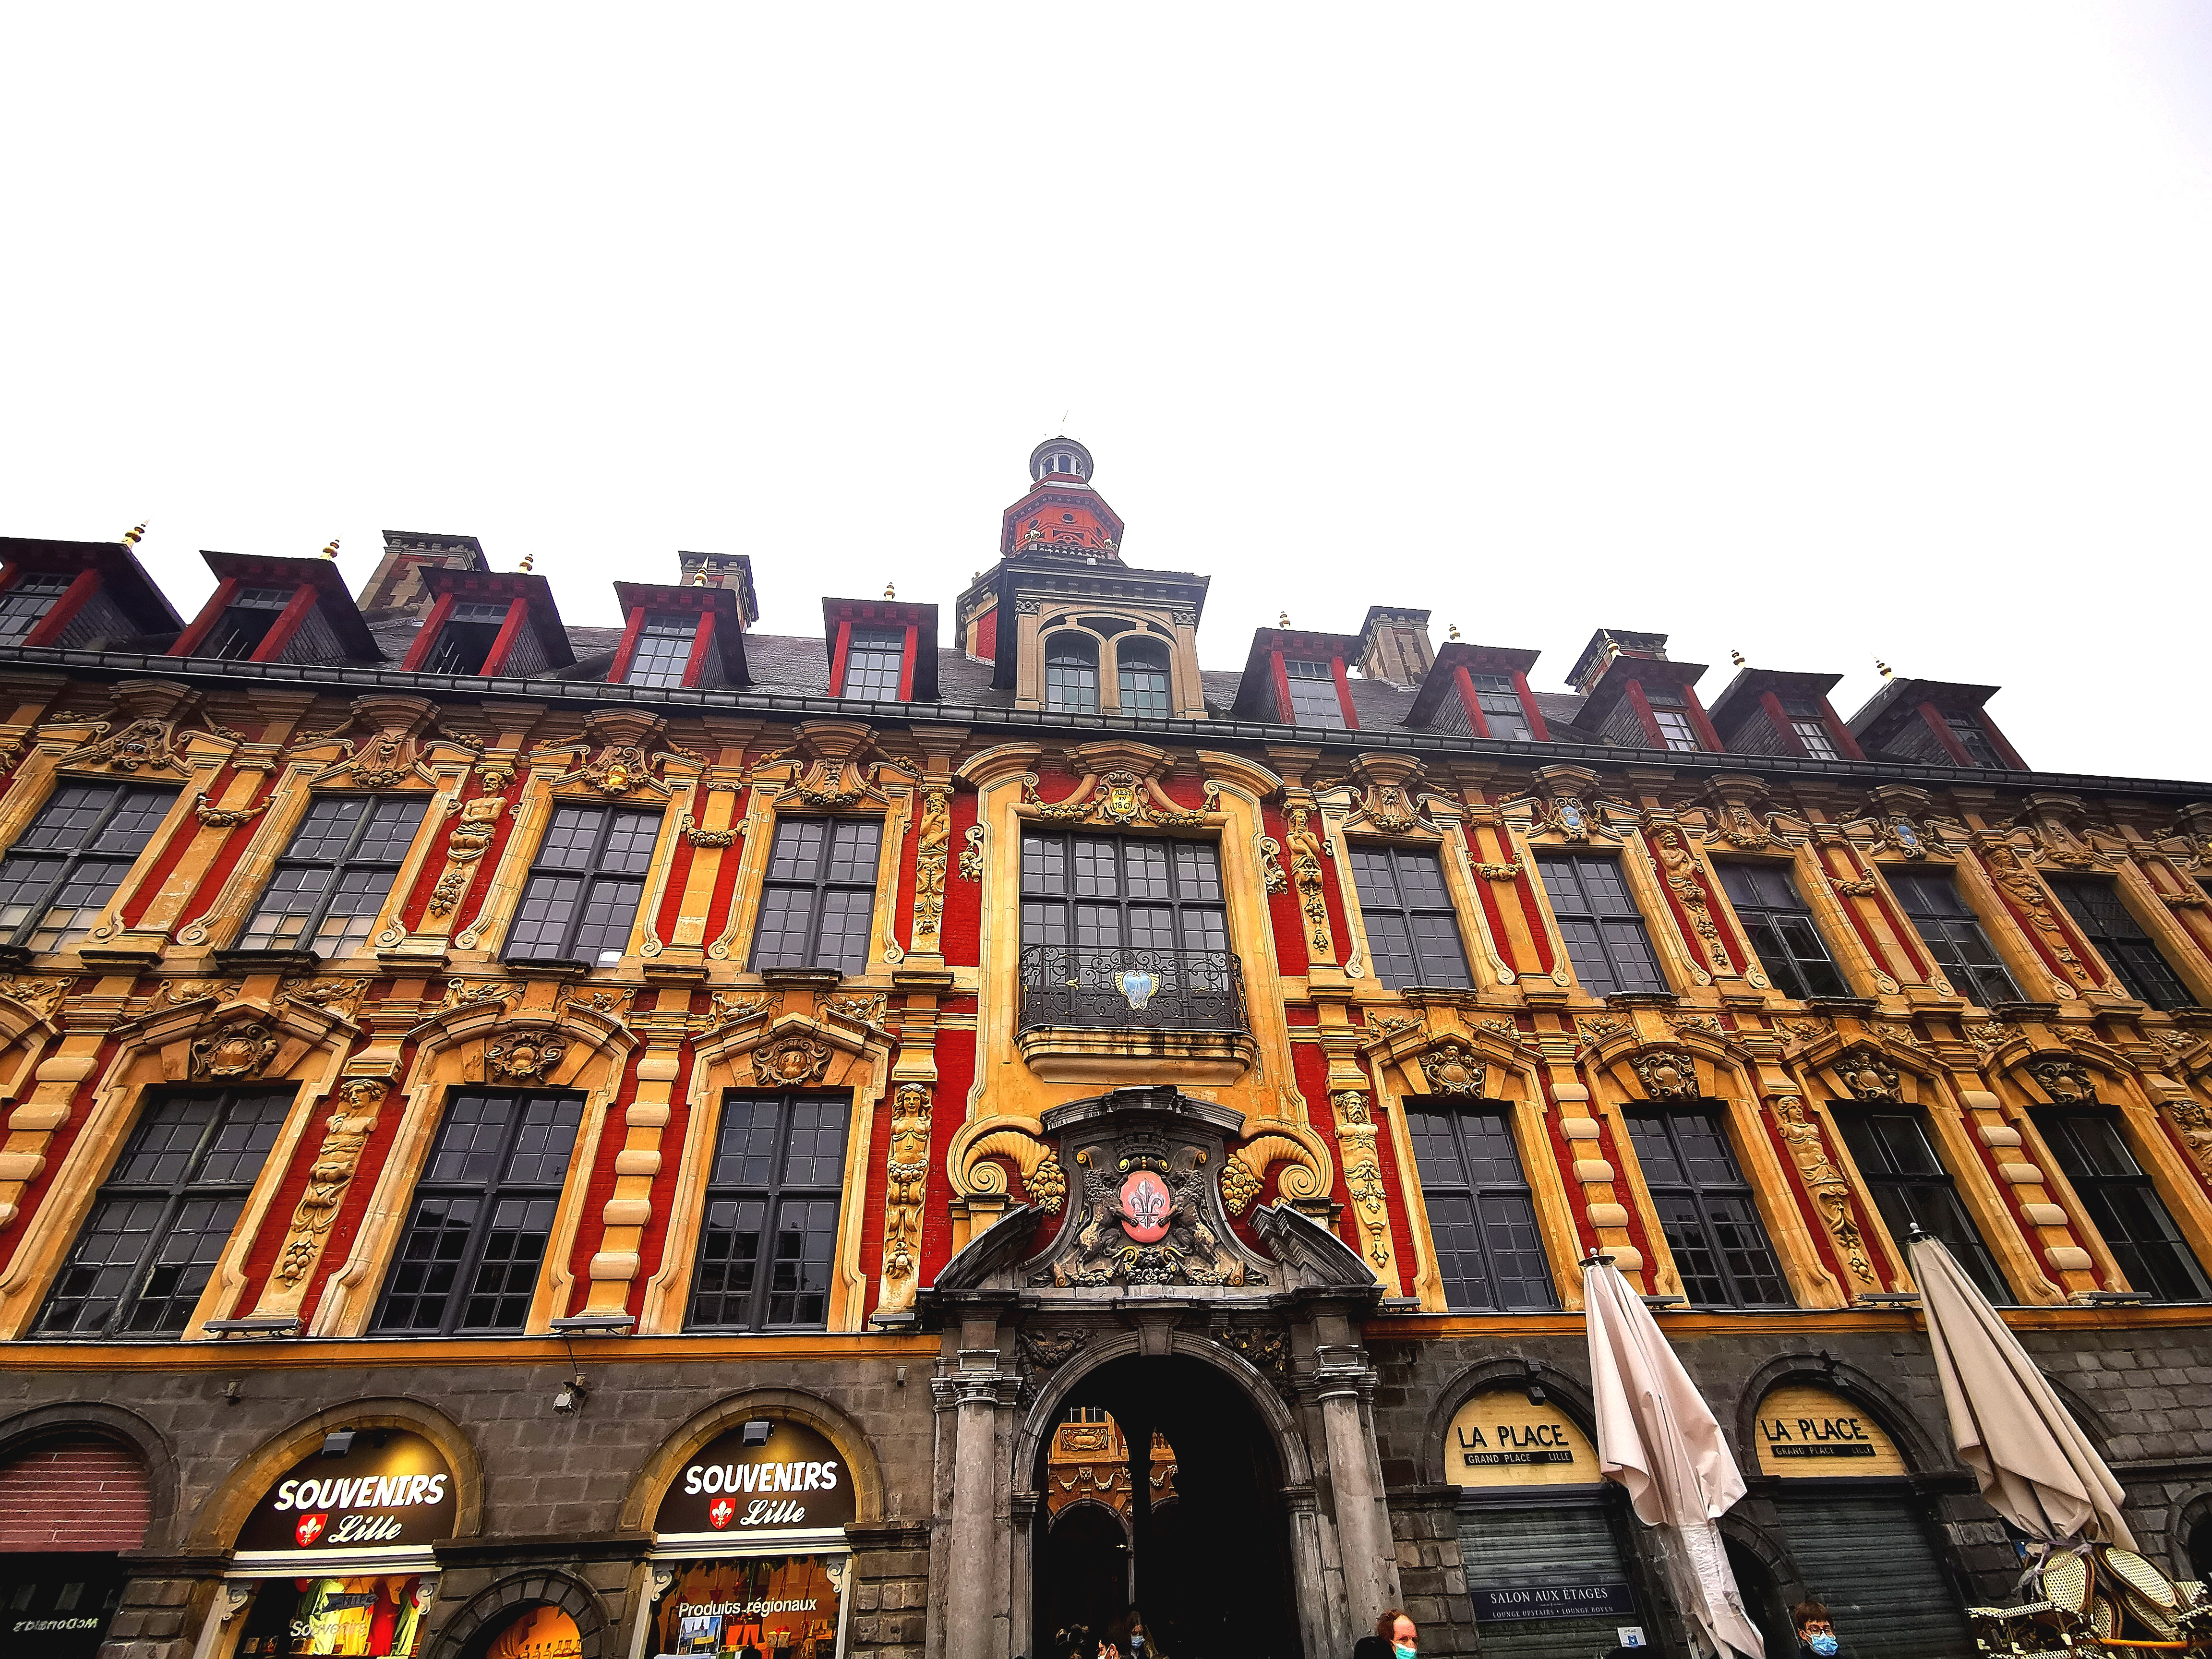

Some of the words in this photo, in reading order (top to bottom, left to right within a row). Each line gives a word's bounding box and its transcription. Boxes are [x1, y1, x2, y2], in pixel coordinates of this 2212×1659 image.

[1458, 1427, 1488, 1448] LA
[1497, 1425, 1569, 1447] PLACE
[1761, 1419, 1792, 1441] LA
[1797, 1418, 1869, 1440] PLACE
[1468, 1454, 1499, 1464] GRAND
[1504, 1453, 1532, 1463] PLACE
[1548, 1452, 1571, 1462] LILLE
[1776, 1447, 1805, 1455] GRAND
[1809, 1446, 1836, 1455] PLACE
[1851, 1446, 1872, 1454] LILLE
[685, 1461, 838, 1495] SOUVENIRS
[274, 1473, 448, 1511] SOUVENIRS
[740, 1498, 805, 1525] Lille
[328, 1515, 402, 1544] Lille
[1490, 1591, 1530, 1604] SALON
[1535, 1590, 1560, 1602] AUX
[1563, 1587, 1608, 1600] ÉTAGES
[678, 1600, 741, 1617] Produits
[746, 1597, 817, 1618] régionaux
